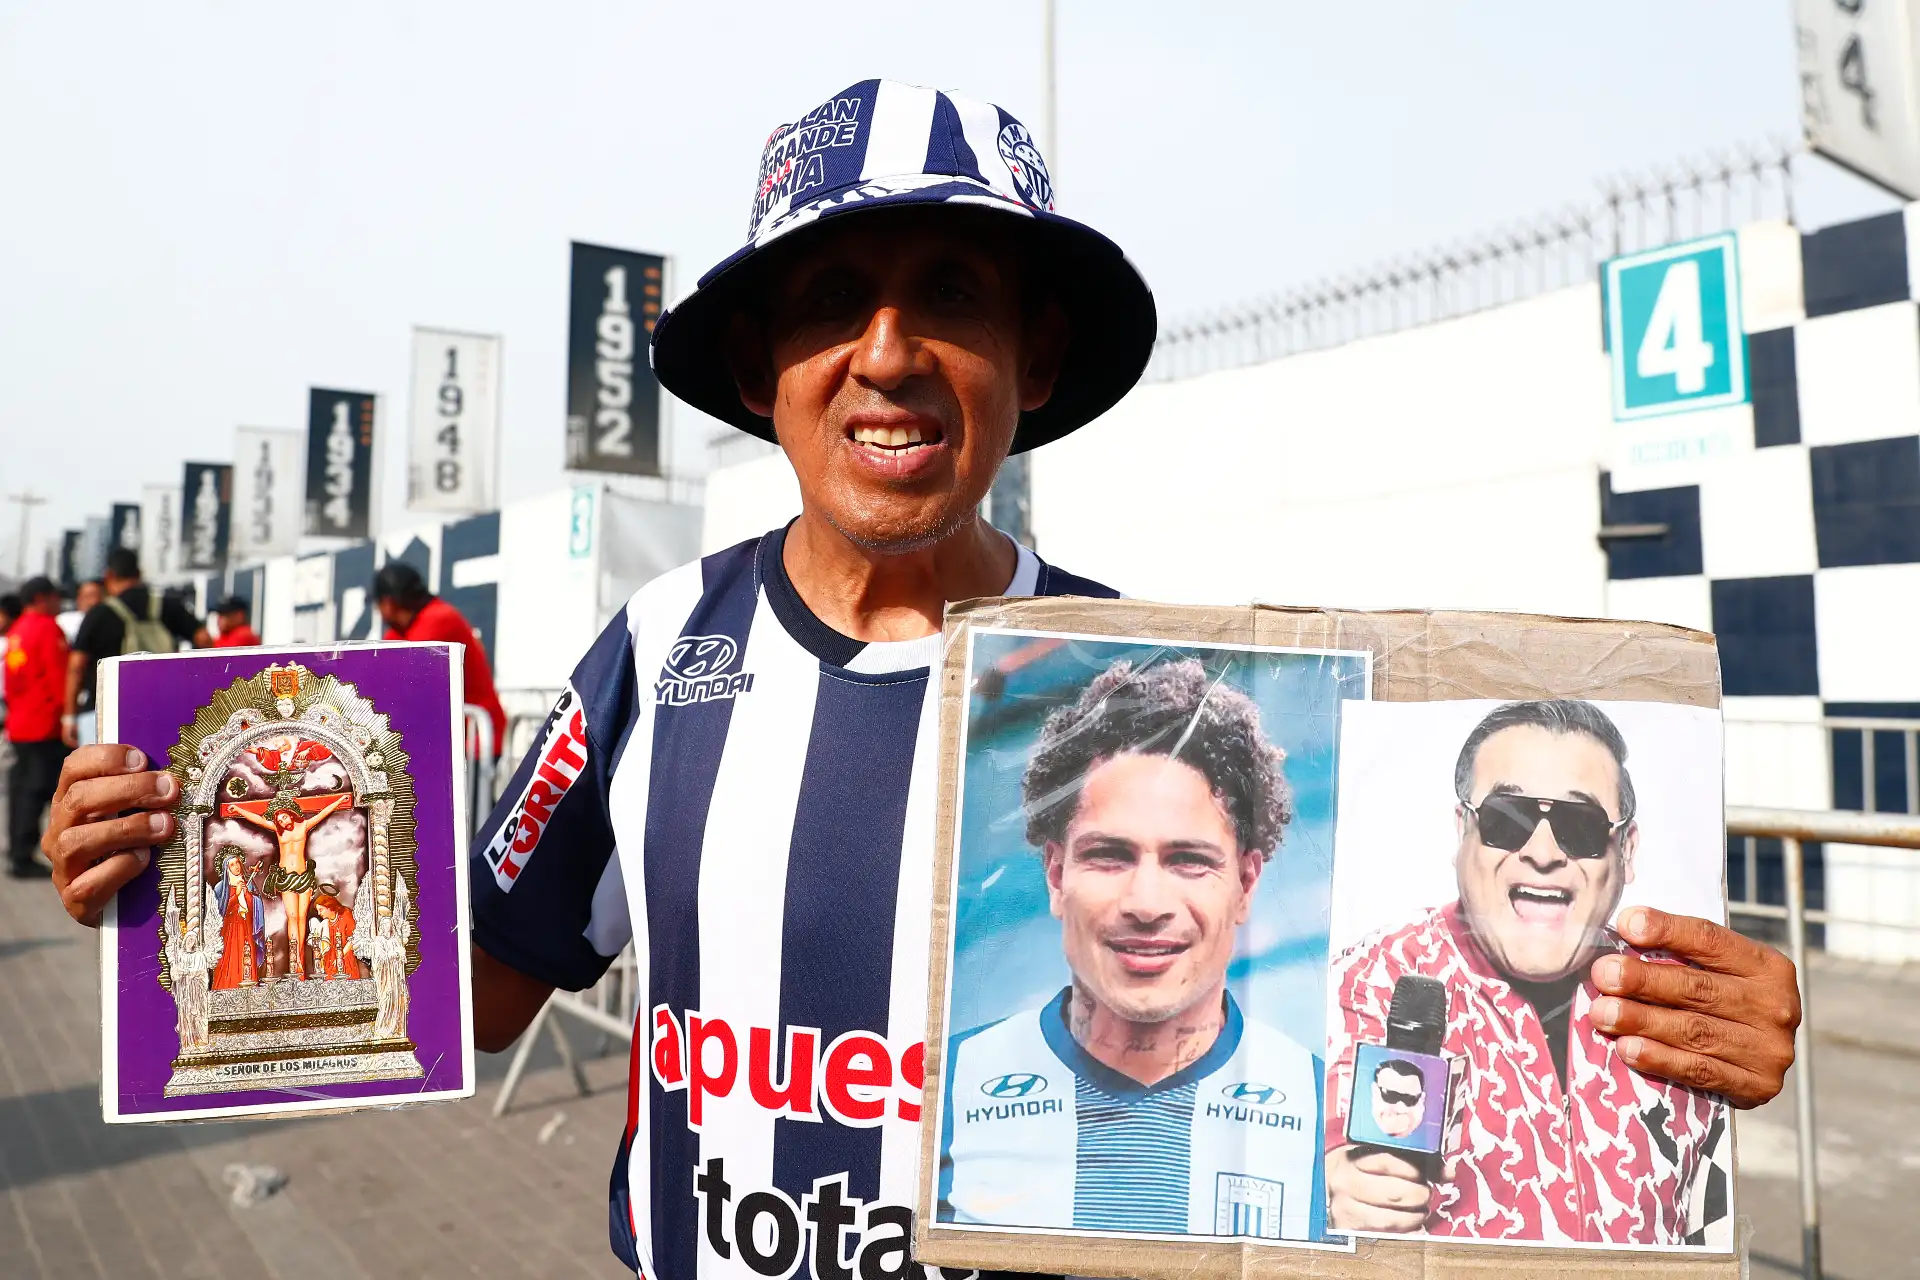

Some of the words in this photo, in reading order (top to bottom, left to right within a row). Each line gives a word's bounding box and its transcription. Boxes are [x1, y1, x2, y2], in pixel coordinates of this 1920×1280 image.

[595, 265, 635, 458] 1952
[1637, 260, 1714, 394] 4
[324, 400, 354, 529] 1934
[435, 346, 463, 494] 1948
[262, 1062, 277, 1073] DE
[280, 1060, 300, 1072] LOS
[966, 1099, 1063, 1124] HYUNDAI
[1206, 1102, 1302, 1131] HYUNDAI
[697, 1156, 975, 1280] tota
